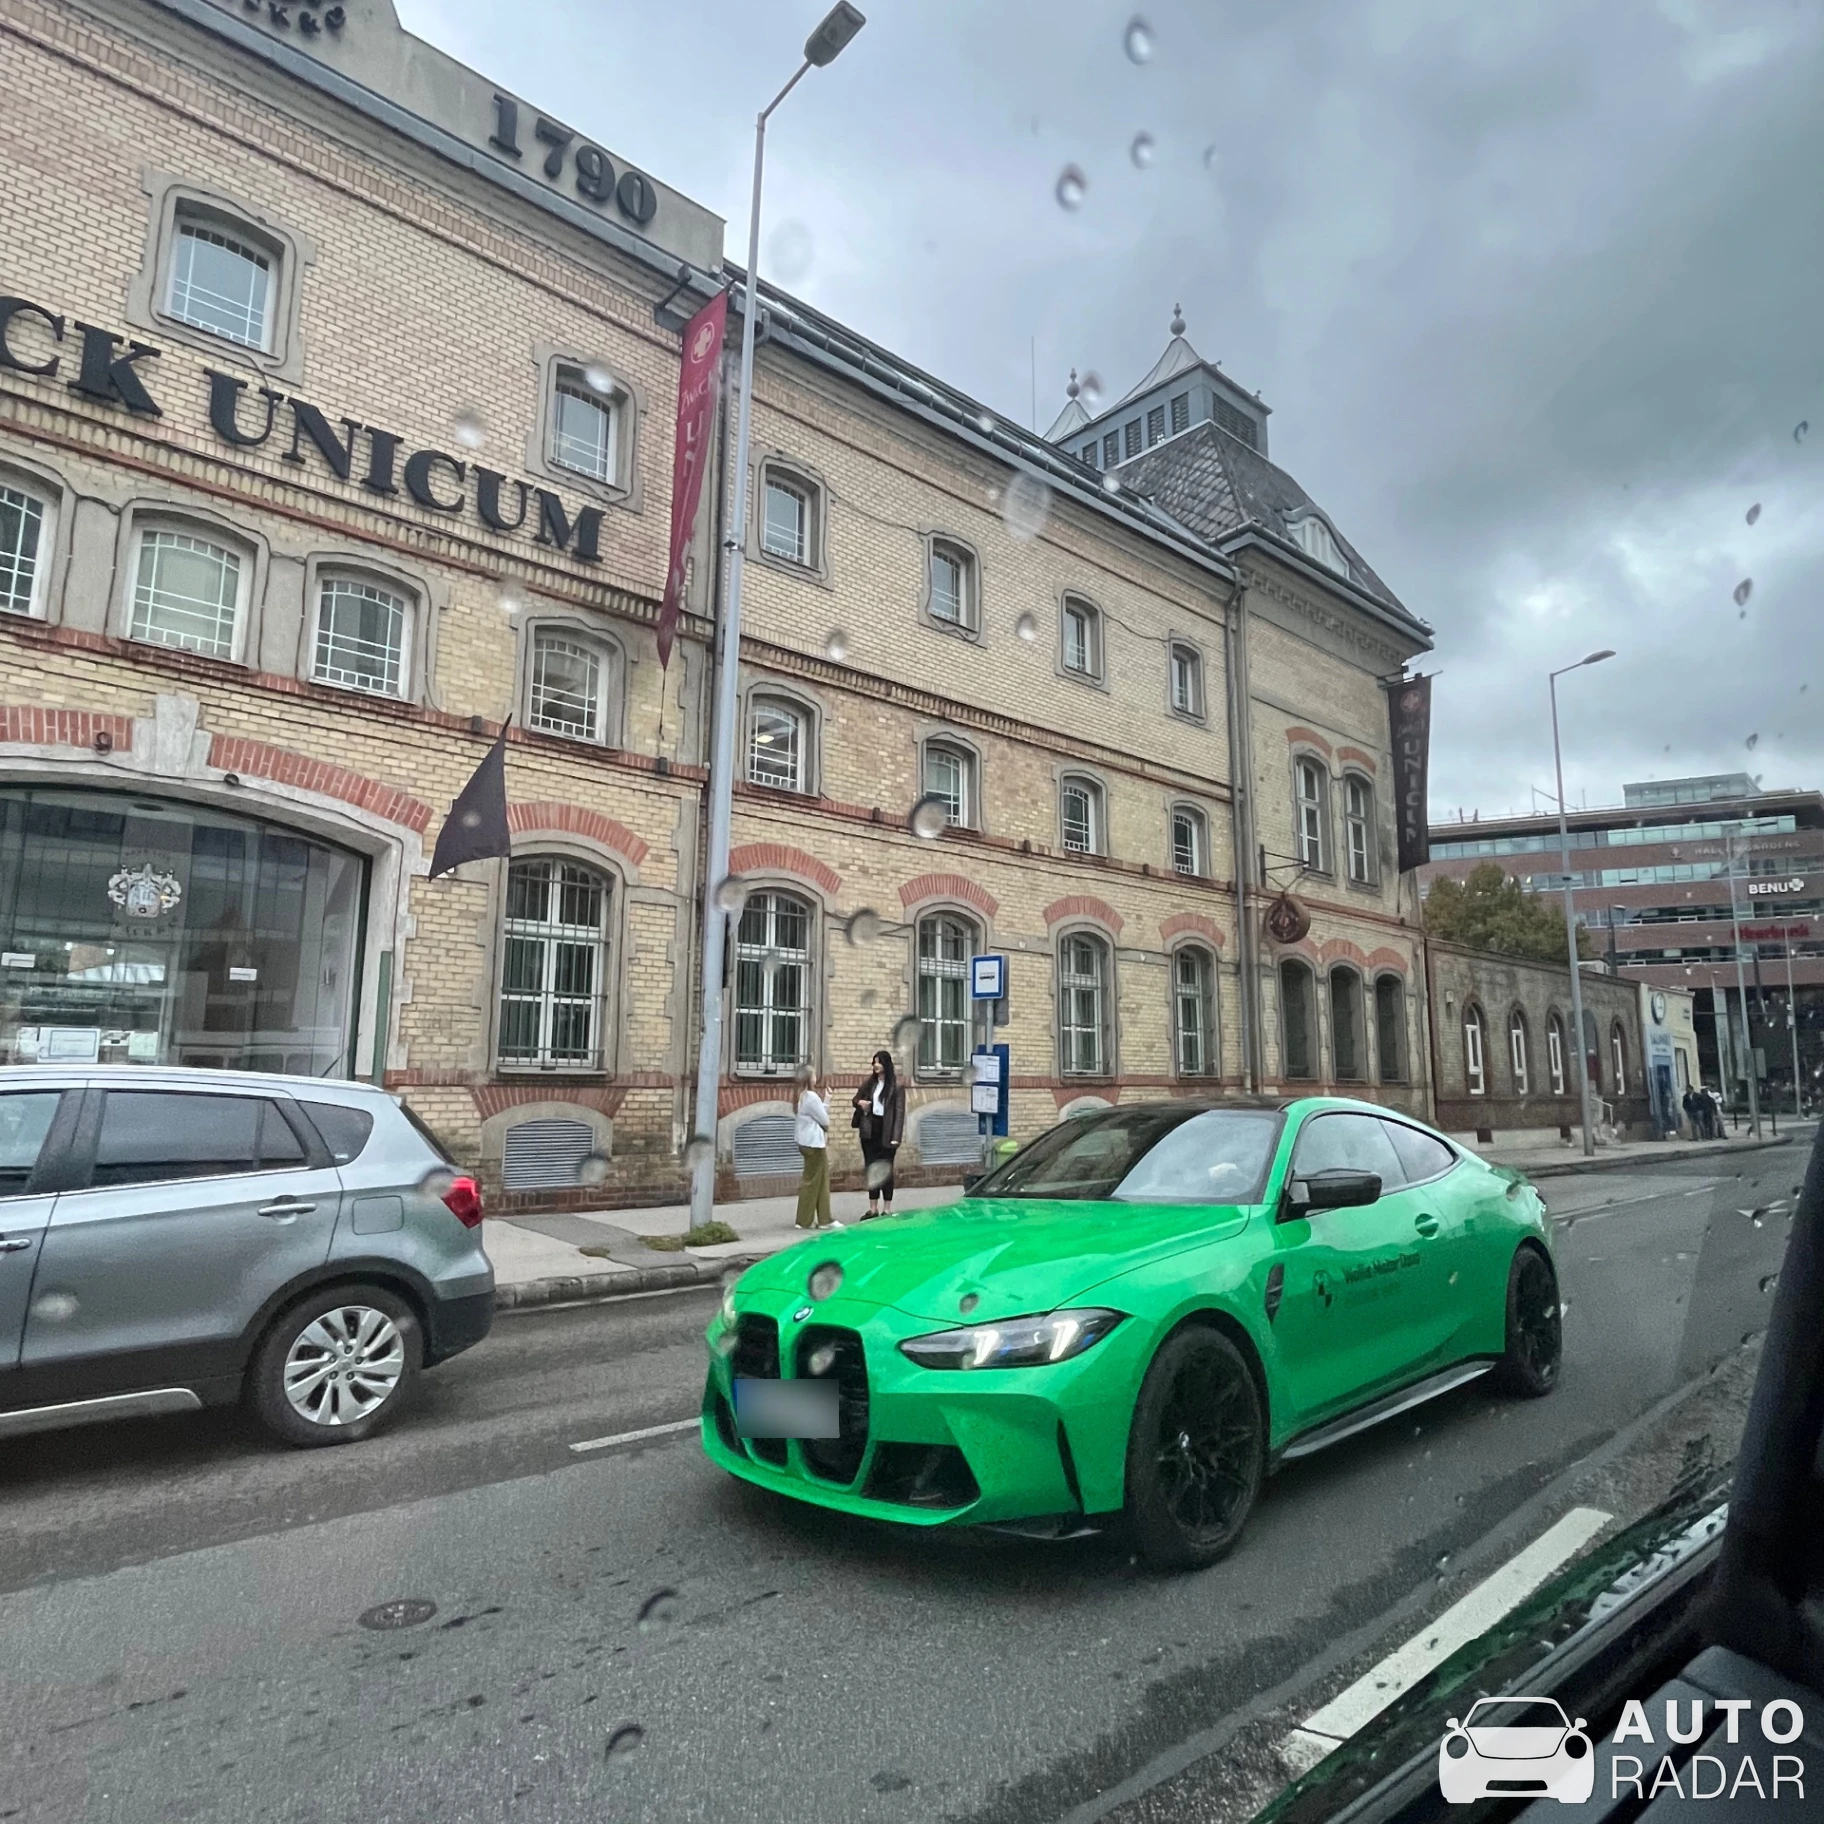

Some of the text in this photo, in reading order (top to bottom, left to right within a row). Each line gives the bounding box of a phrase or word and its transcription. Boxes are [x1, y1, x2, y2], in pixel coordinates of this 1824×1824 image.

[487, 93, 656, 224] 1790
[203, 367, 606, 562] UNICUM
[1748, 881, 1789, 895] BENU
